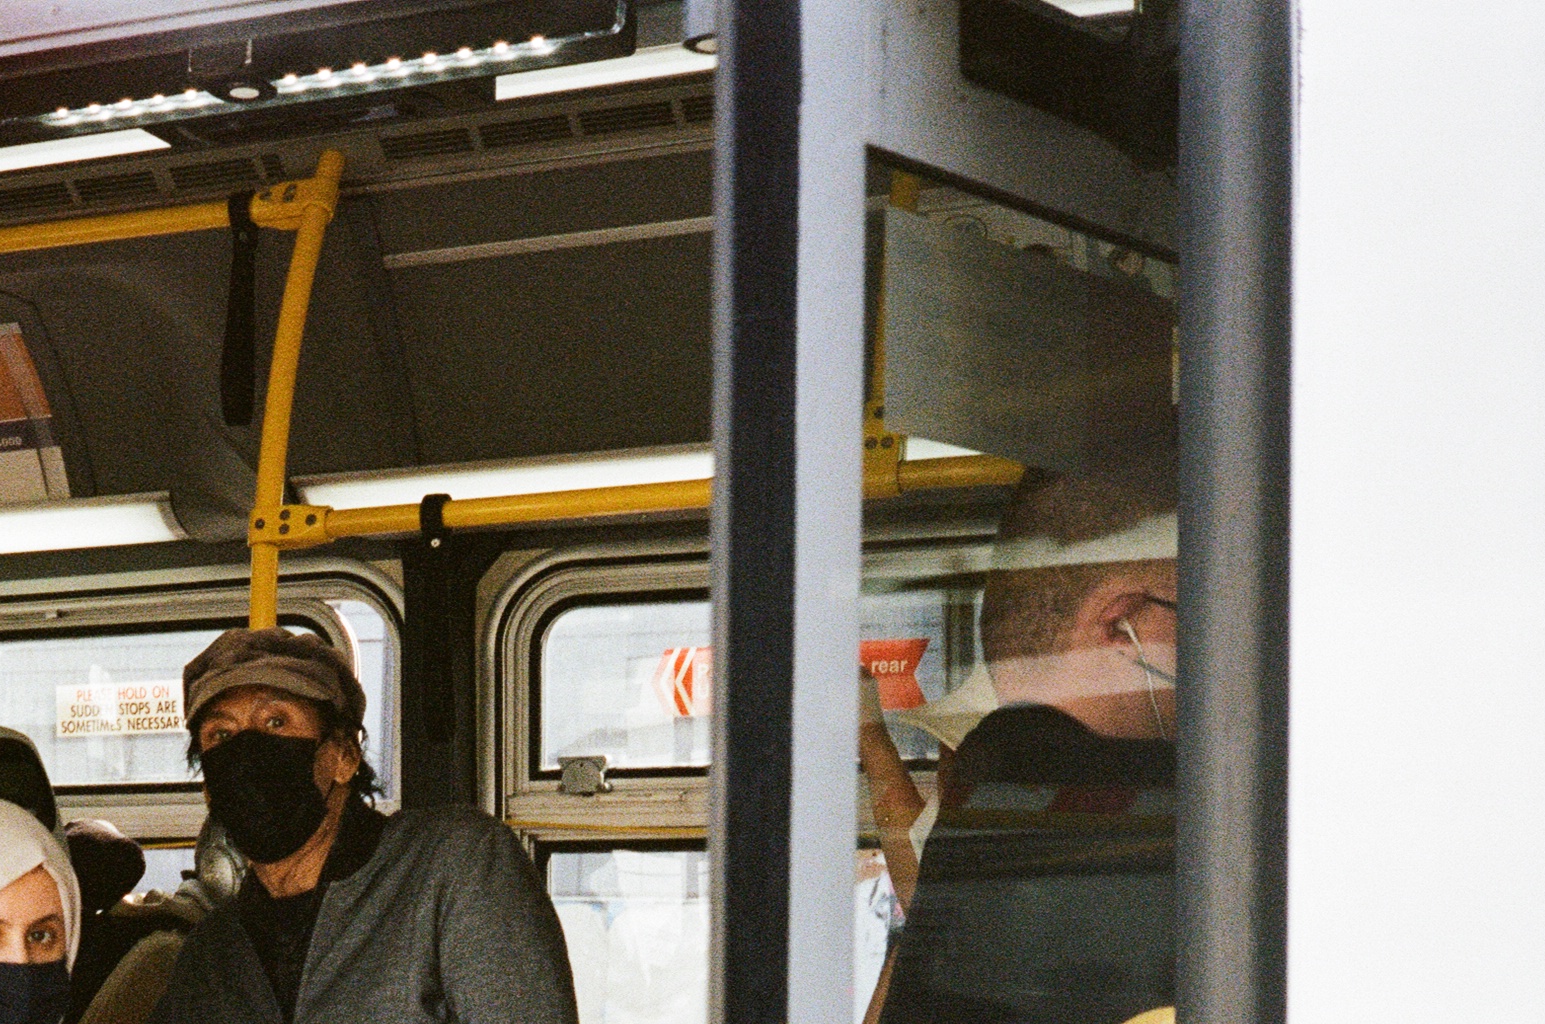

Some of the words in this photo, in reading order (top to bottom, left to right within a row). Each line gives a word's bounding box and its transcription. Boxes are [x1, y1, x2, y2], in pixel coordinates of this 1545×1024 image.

[871, 659, 909, 674] rear
[117, 686, 147, 700] HOLD
[152, 685, 170, 698] ON
[118, 702, 151, 715] STOPS
[156, 700, 177, 714] ARE
